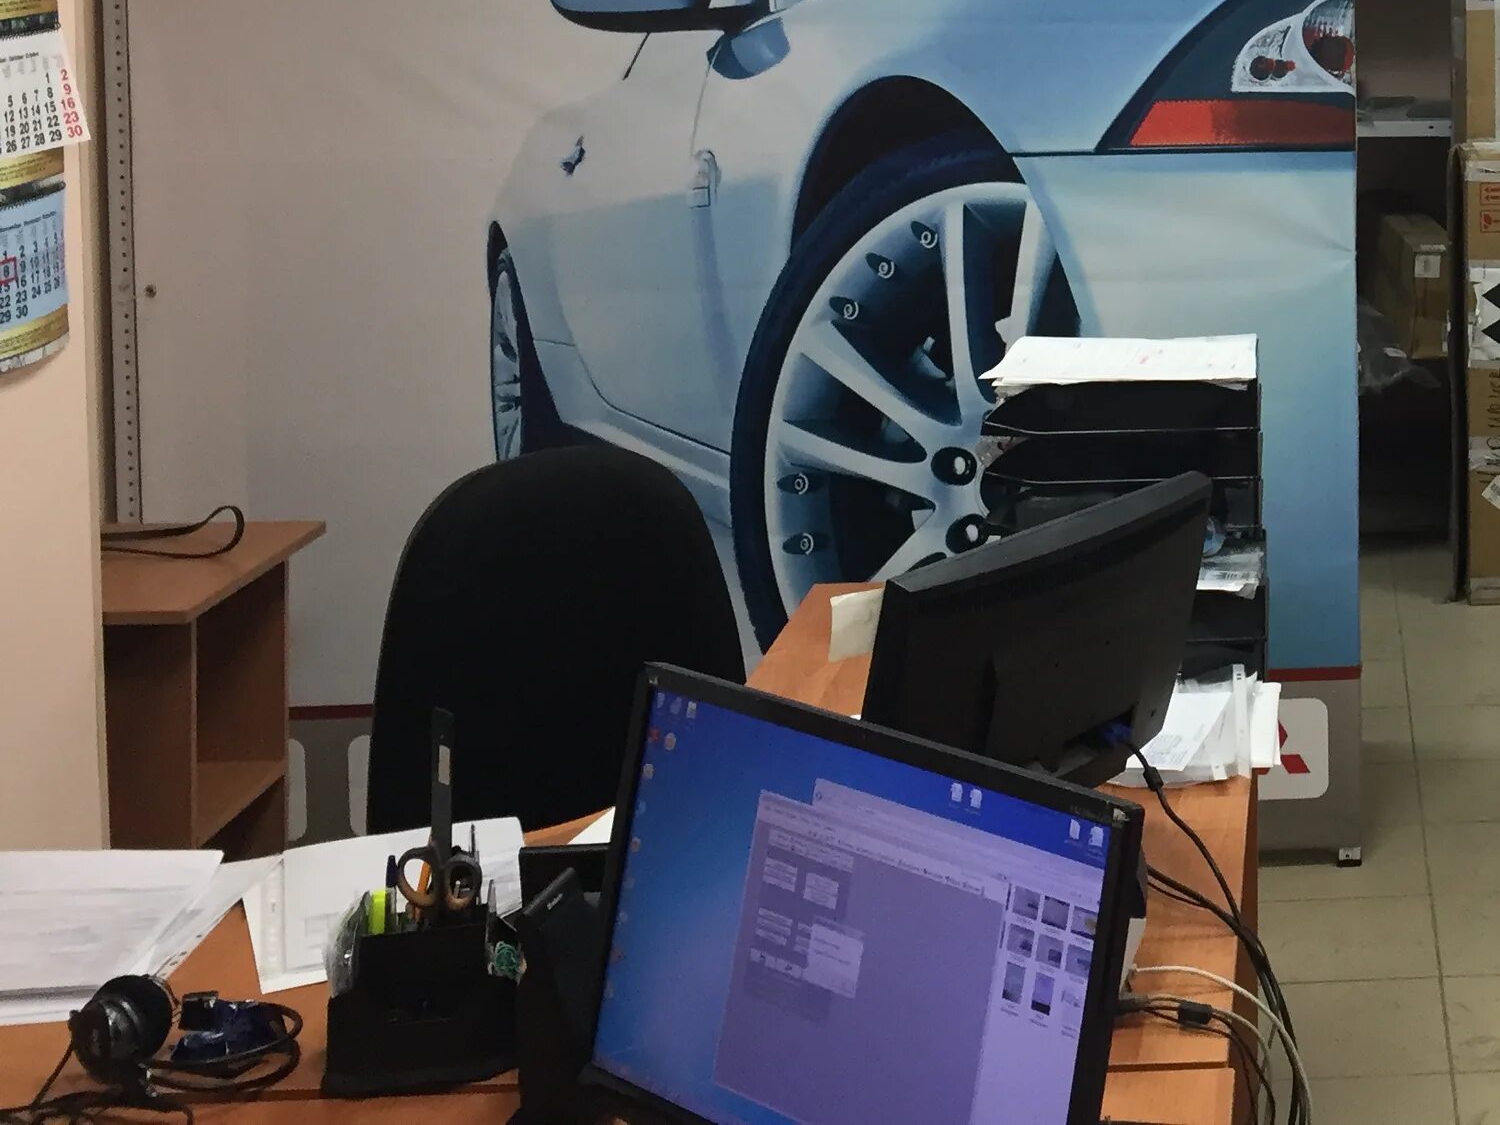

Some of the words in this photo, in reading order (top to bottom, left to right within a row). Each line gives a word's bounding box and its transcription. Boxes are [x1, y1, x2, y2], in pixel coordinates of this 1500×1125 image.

[4, 110, 15, 123] 12
[18, 107, 29, 120] 13
[31, 105, 41, 117] 14
[44, 101, 57, 114] 15
[61, 98, 76, 110] 16
[5, 125, 16, 138] 19
[19, 122, 30, 135] 20
[33, 119, 42, 132] 21
[46, 114, 60, 128] 22
[63, 111, 80, 124] 23
[6, 139, 18, 153] 26
[21, 136, 31, 149] 27
[34, 133, 46, 146] 28
[49, 129, 63, 143] 29
[67, 125, 83, 138] 30
[30, 271, 40, 284] 17
[15, 290, 28, 304] 23
[31, 285, 42, 299] 24
[15, 305, 29, 319] 30
